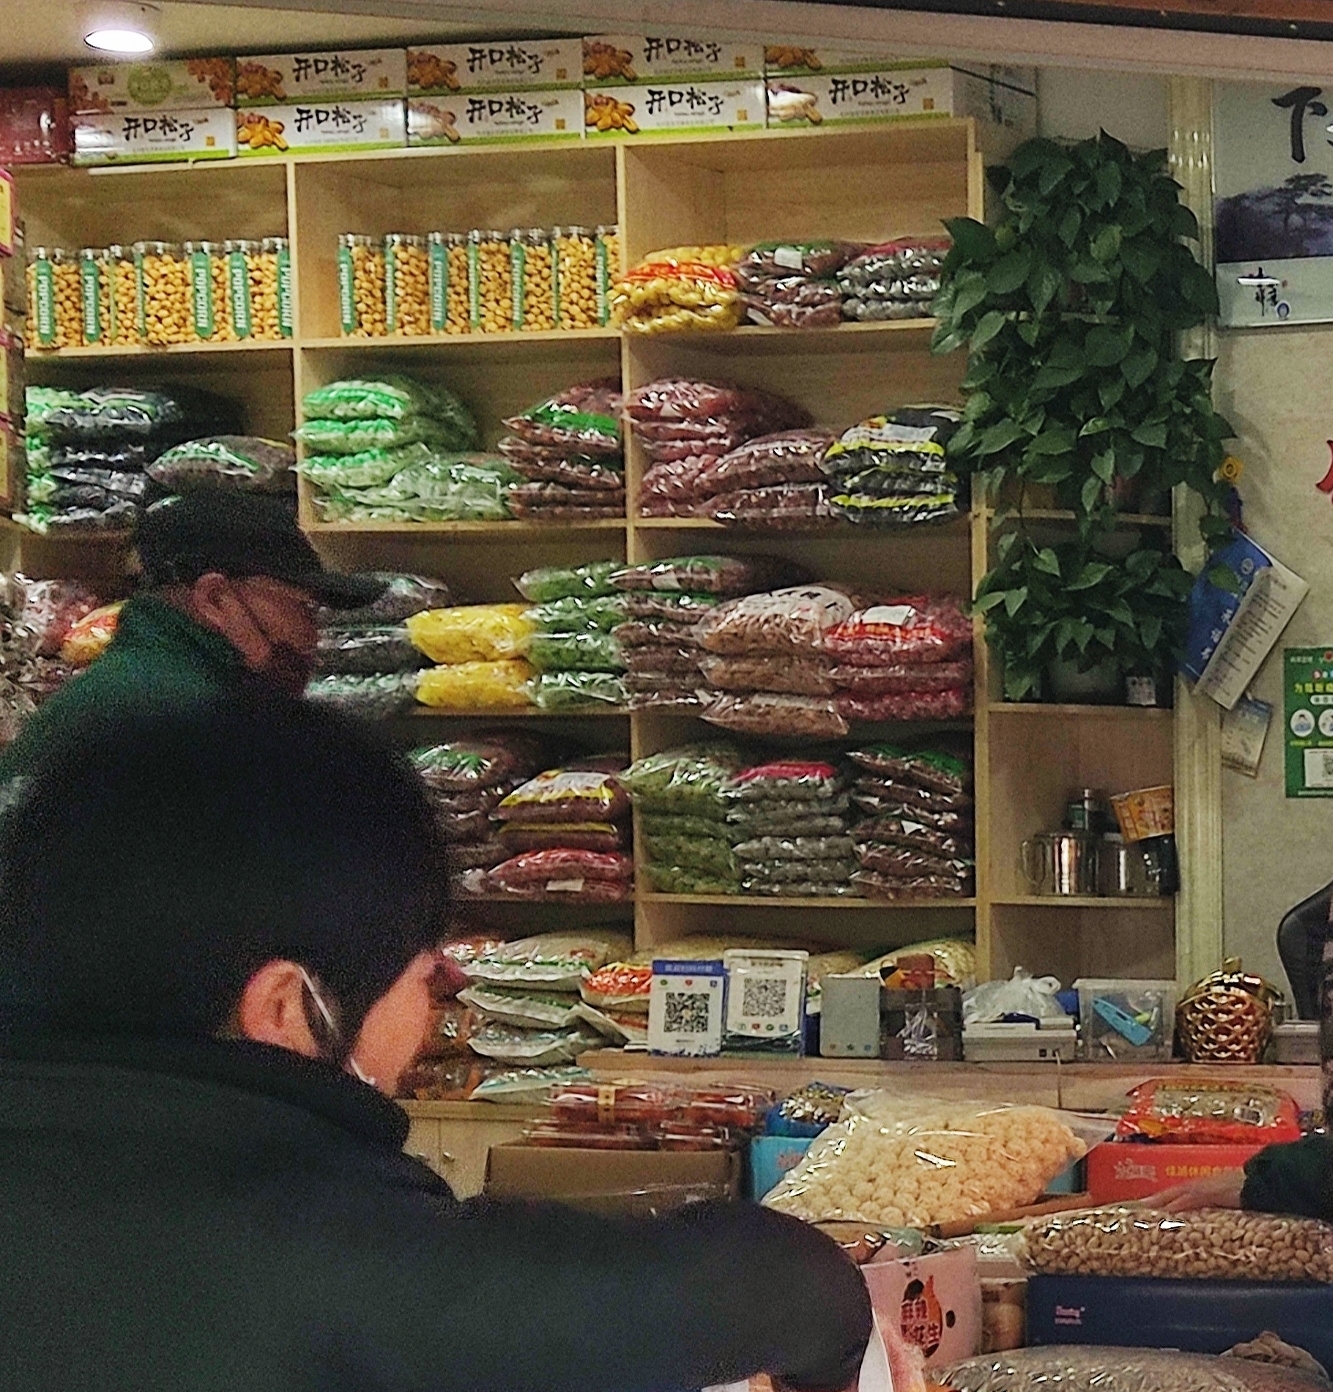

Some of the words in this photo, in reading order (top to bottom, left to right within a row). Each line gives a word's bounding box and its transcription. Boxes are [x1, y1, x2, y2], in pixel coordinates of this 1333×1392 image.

[292, 55, 366, 83] 开口松子
[467, 45, 544, 74] 开口松子
[645, 88, 724, 115] 开口松子
[828, 77, 910, 104] 开口松子
[294, 105, 367, 133] 开口松子
[466, 95, 543, 123] 开口松子
[123, 115, 194, 142] 开口松子
[195, 268, 208, 328] POPCORN
[232, 268, 246, 328] POPCORN
